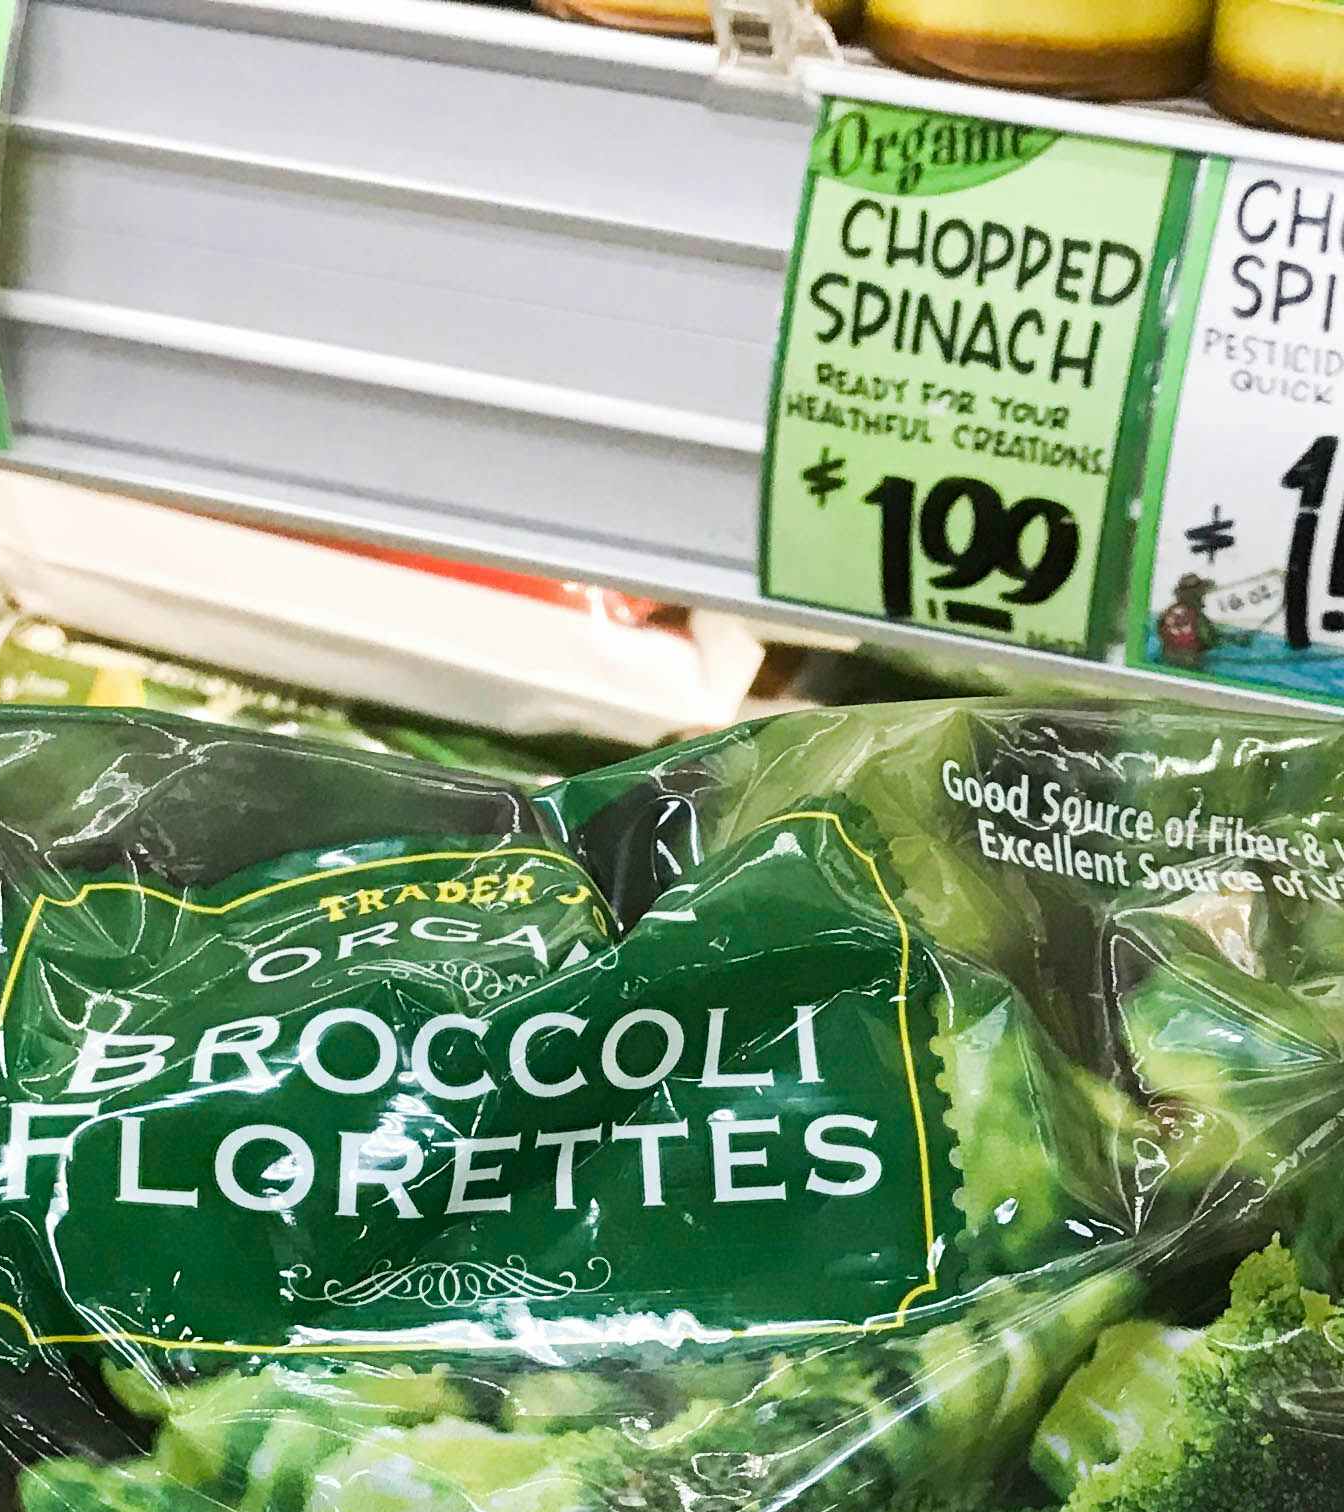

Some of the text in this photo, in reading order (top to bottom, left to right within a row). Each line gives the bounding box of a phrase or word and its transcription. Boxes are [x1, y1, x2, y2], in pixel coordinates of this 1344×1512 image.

[842, 199, 1144, 307] CHOPPED
[810, 272, 1103, 388] SPINACH
[816, 363, 911, 405] READY
[992, 395, 1071, 431] YOUR
[1231, 370, 1333, 406] QUICK
[942, 759, 1030, 820] Good
[1044, 782, 1155, 841] Source
[1164, 811, 1200, 850] of
[318, 873, 536, 924] TRADER
[977, 818, 1131, 889] Excellent
[1141, 855, 1264, 894] Source
[1273, 872, 1307, 901] of
[65, 1002, 826, 1102] BROCCOLI
